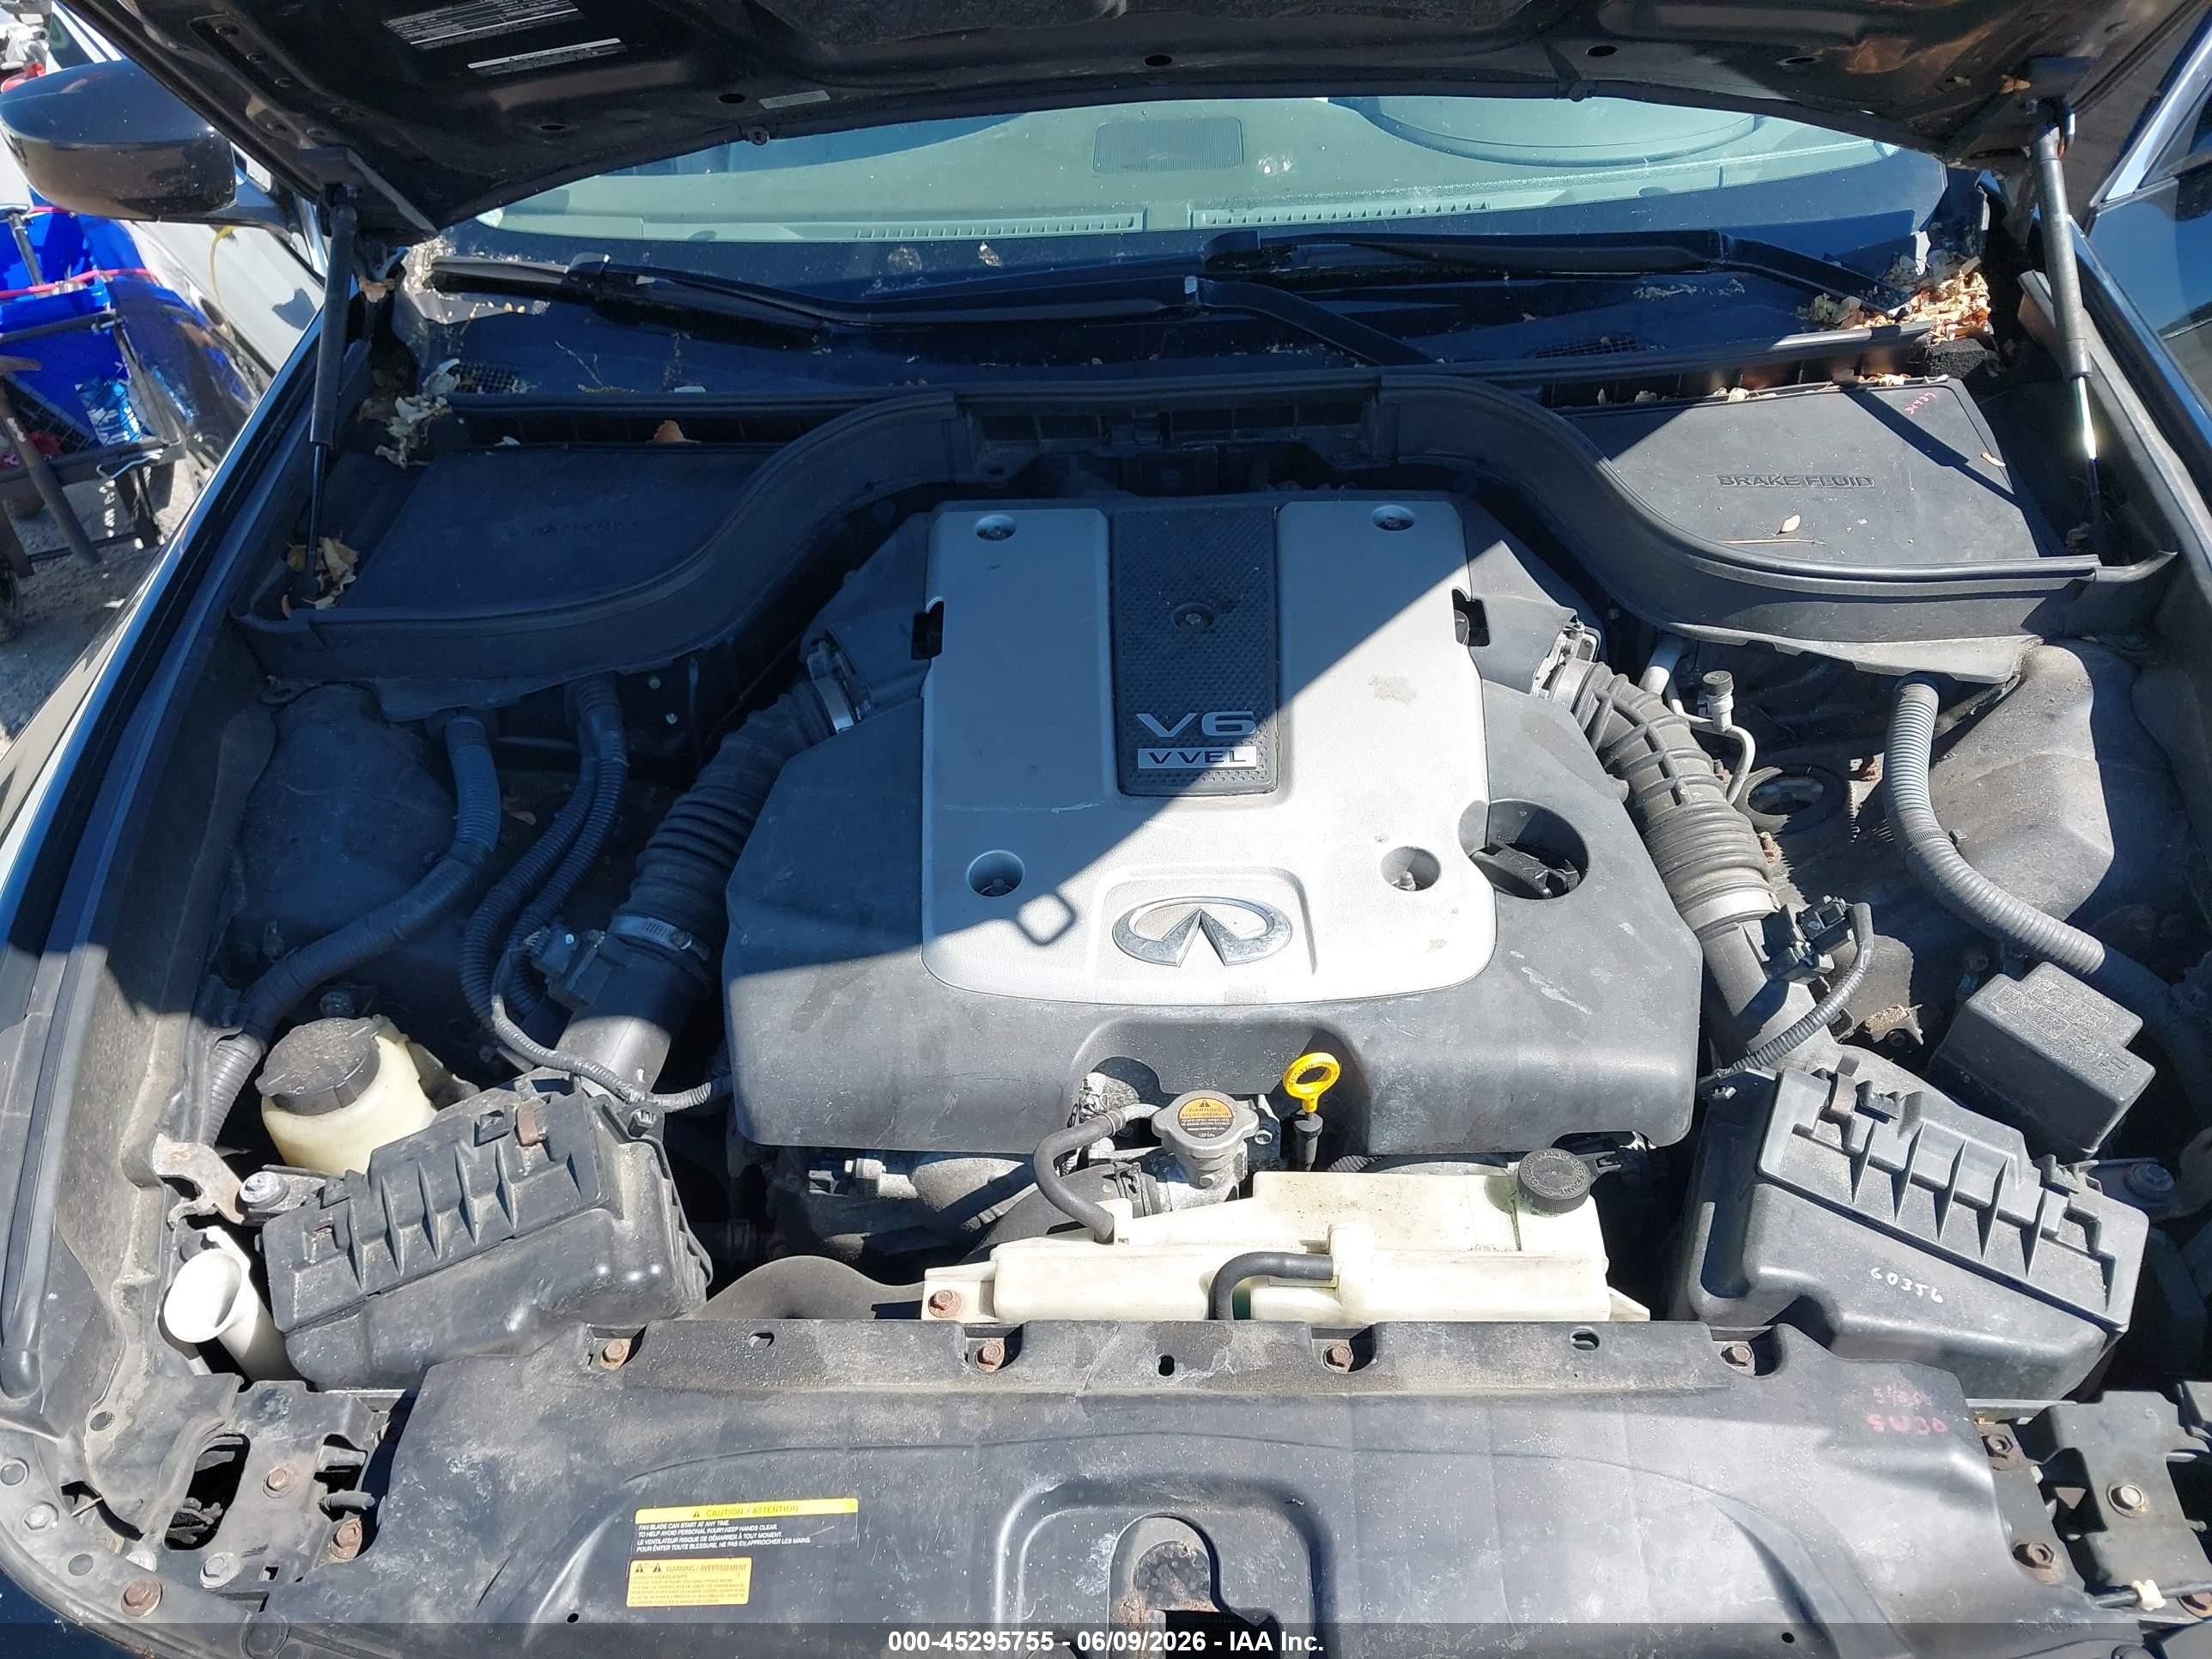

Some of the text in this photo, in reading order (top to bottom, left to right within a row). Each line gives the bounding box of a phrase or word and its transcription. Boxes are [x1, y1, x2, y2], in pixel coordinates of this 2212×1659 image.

[1716, 473, 1876, 489] BRAKE FLUID
[1135, 710, 1257, 738] V6
[1146, 750, 1247, 764] VVEL
[706, 1508, 744, 1517] CAUTION
[752, 1504, 799, 1514] ATTENTION
[644, 1536, 678, 1545] VENTILATEUR
[678, 1534, 699, 1543] RISQUE
[710, 1533, 738, 1541] DÉMARRER
[745, 1537, 781, 1547] APPROCHER
[781, 1536, 792, 1545] LES
[700, 1564, 747, 1572] AVERTISSEMENT
